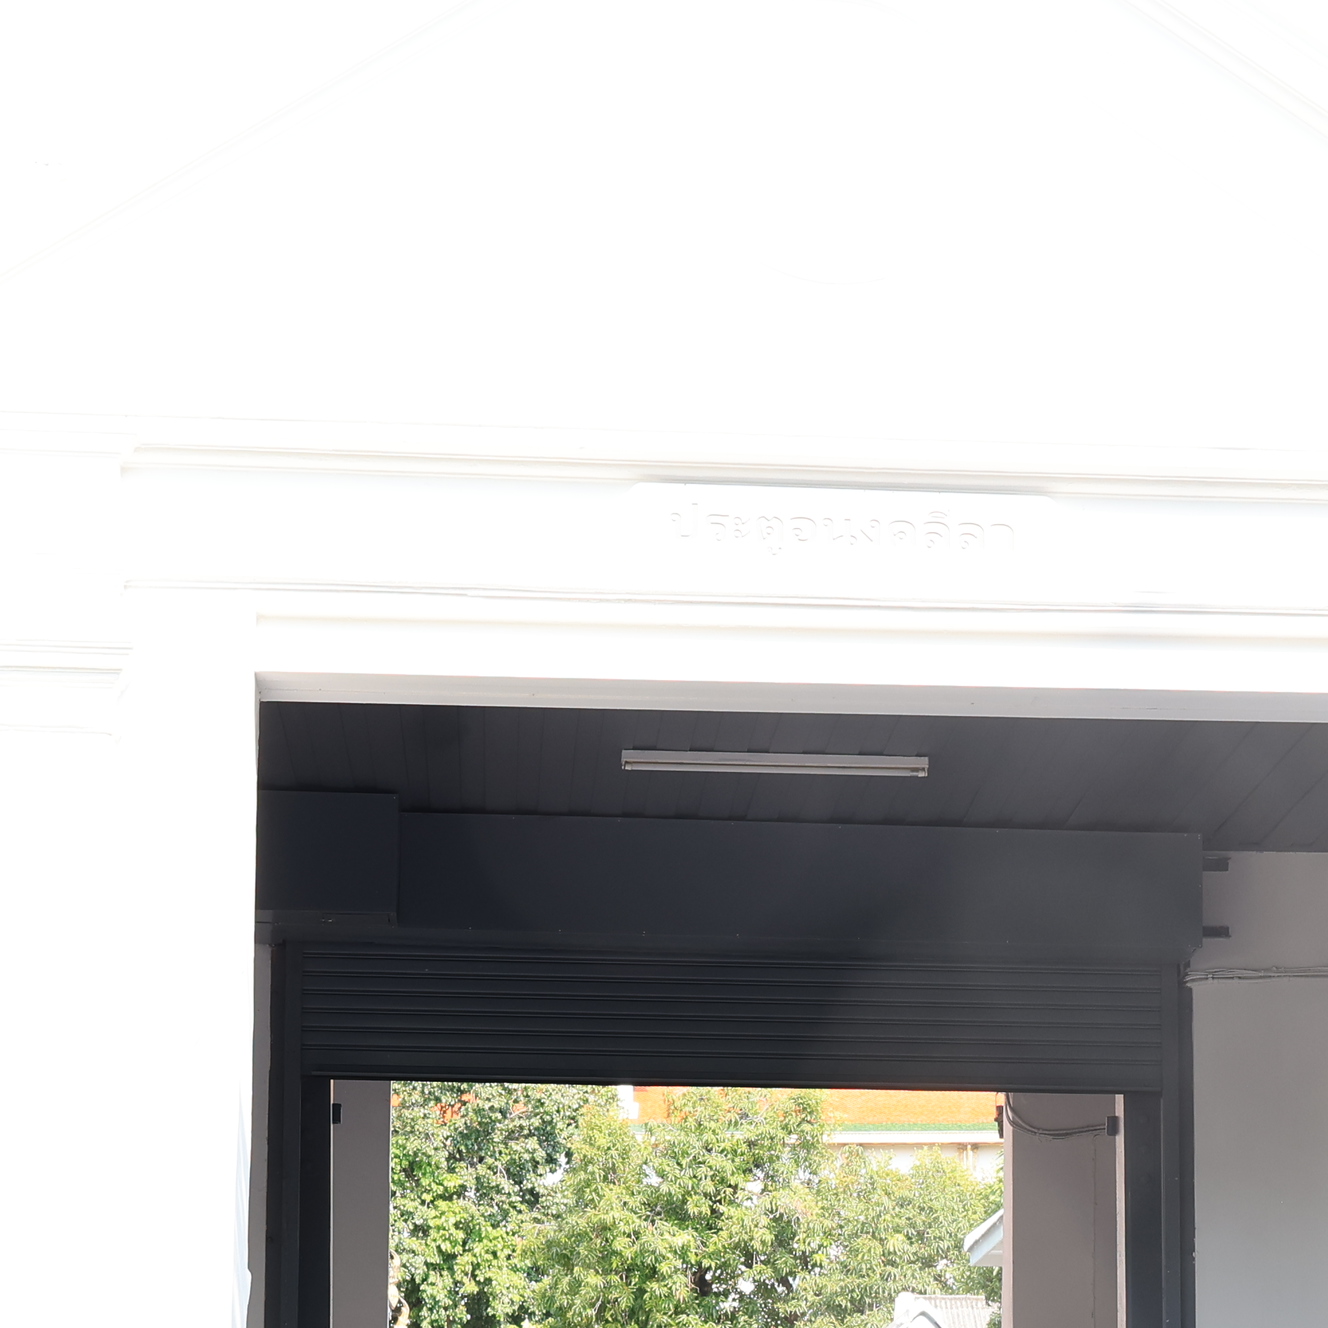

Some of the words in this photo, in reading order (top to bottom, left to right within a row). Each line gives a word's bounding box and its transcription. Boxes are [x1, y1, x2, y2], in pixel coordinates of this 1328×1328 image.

[670, 502, 1016, 556] ประตูอนงคลีลา
